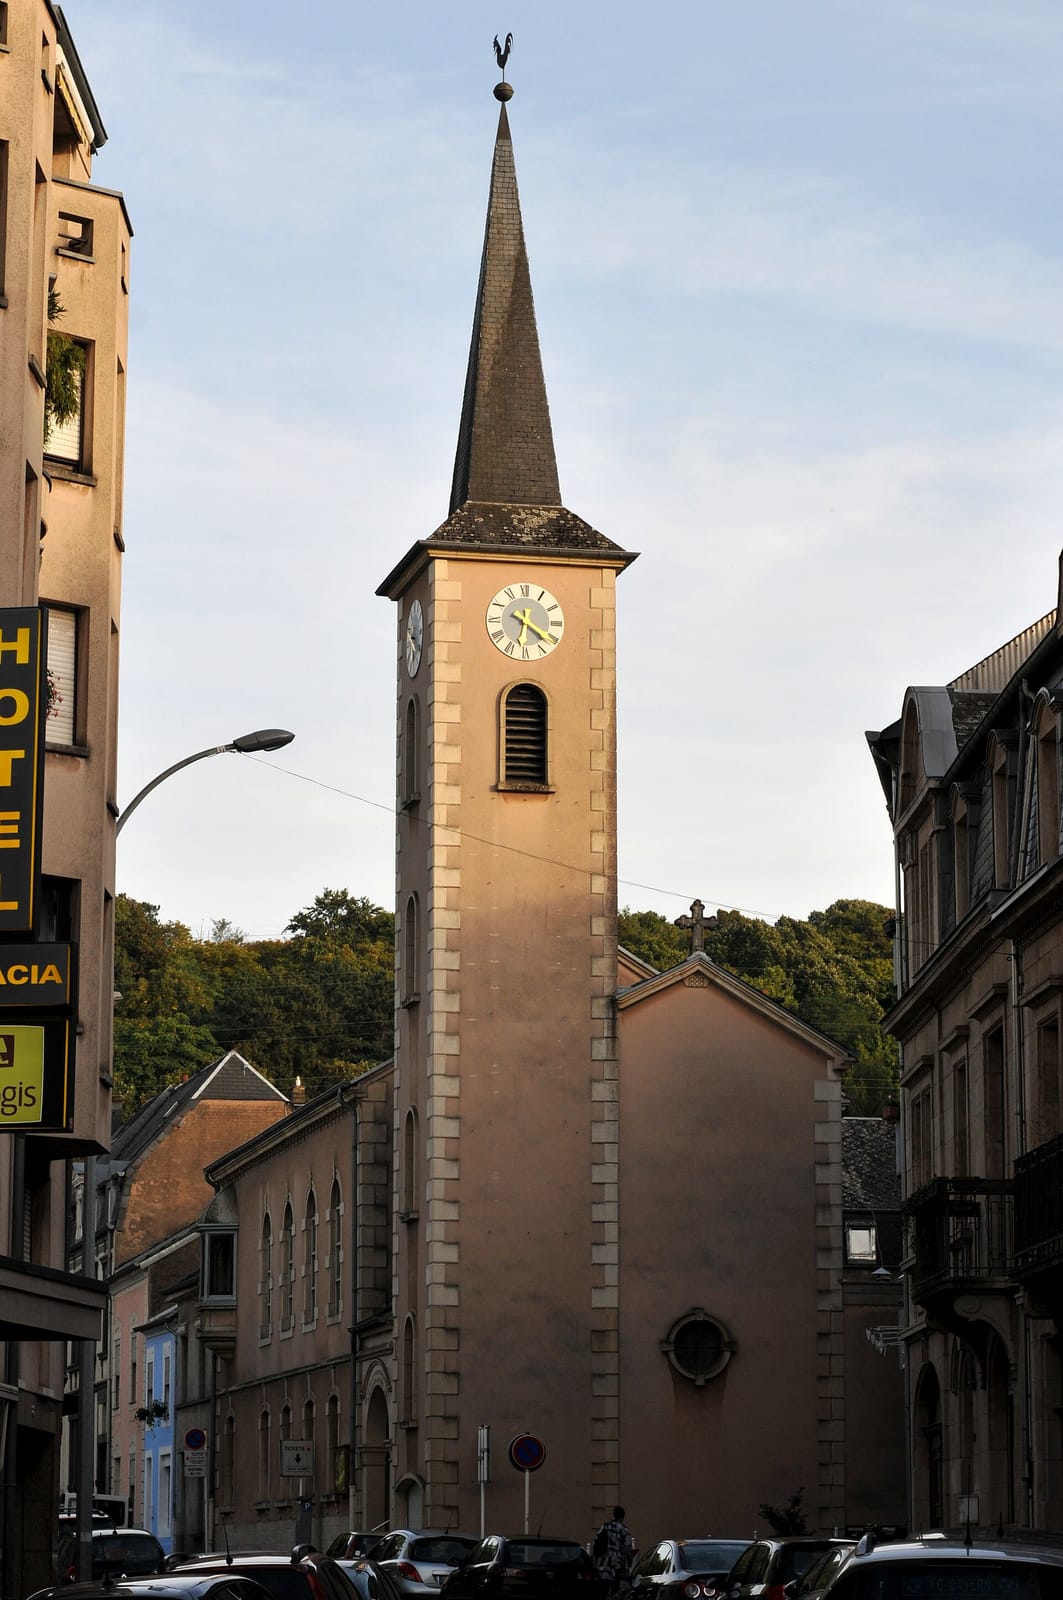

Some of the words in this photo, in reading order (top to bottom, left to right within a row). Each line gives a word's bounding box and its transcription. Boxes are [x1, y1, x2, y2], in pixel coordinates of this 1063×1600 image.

[504, 587, 515, 601] XI
[520, 585, 530, 597] XII
[538, 591, 545, 601] I
[492, 599, 505, 611] X
[0, 964, 63, 985] CIA
[0, 1081, 36, 1116] gis
[304, 1503, 311, 1511] P
